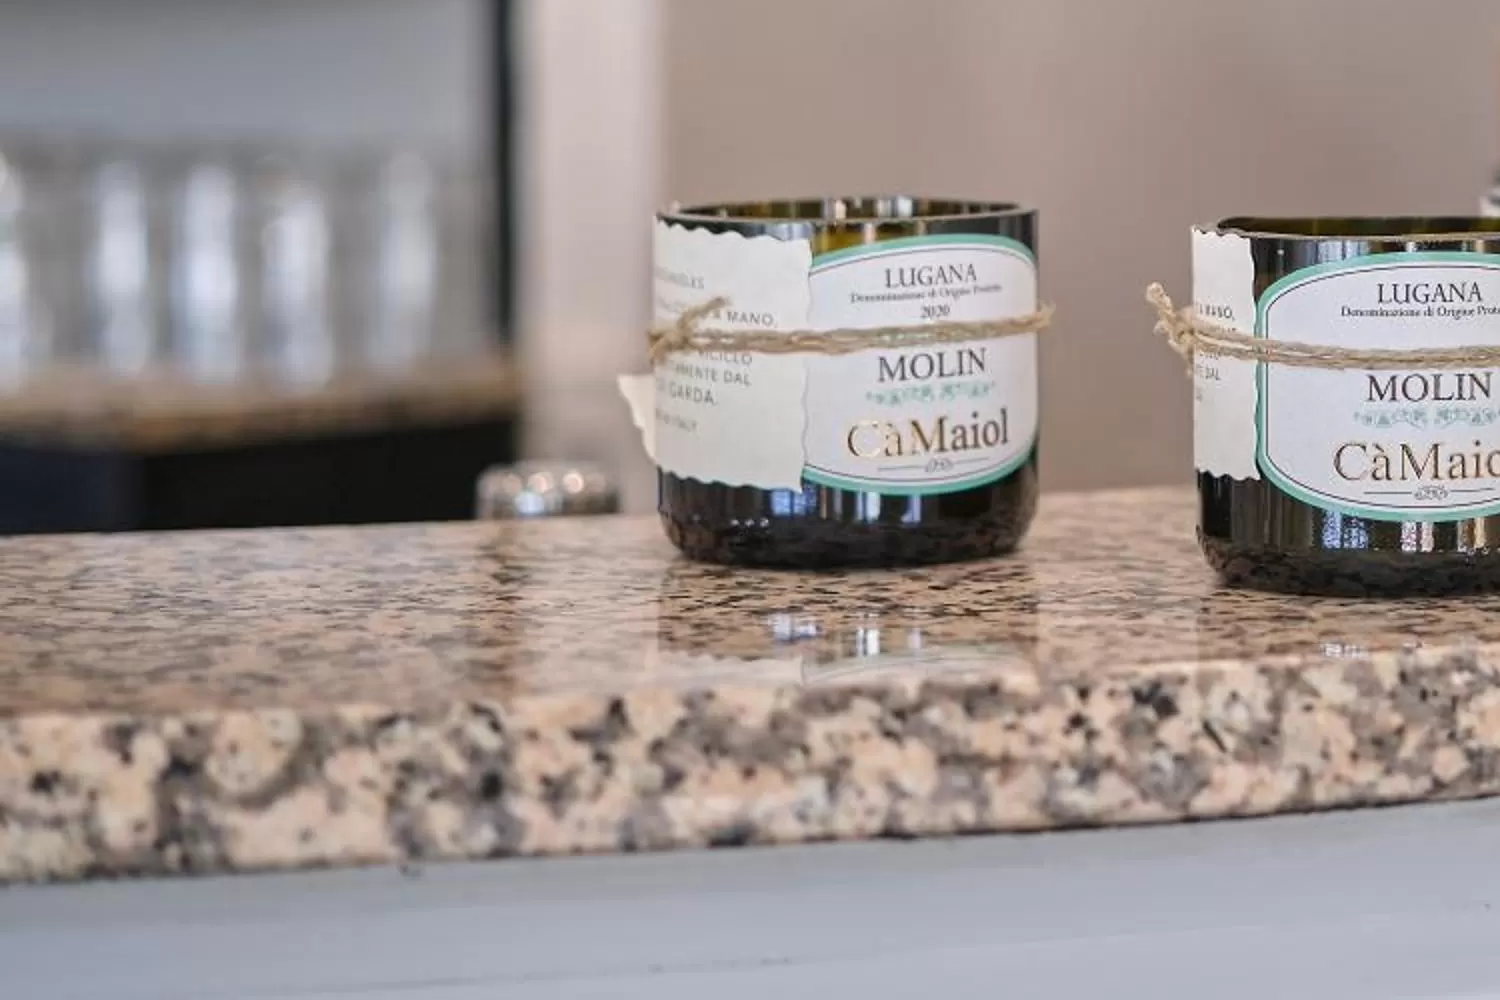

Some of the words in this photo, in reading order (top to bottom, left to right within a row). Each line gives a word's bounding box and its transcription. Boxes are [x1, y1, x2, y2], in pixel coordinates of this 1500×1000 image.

[885, 263, 977, 289] LUGANA
[1377, 281, 1482, 304] LUGANA
[1341, 305, 1421, 317] Denominazione
[1424, 306, 1434, 317] di
[878, 347, 986, 383] MOLIN
[1366, 371, 1493, 402] MOLIN
